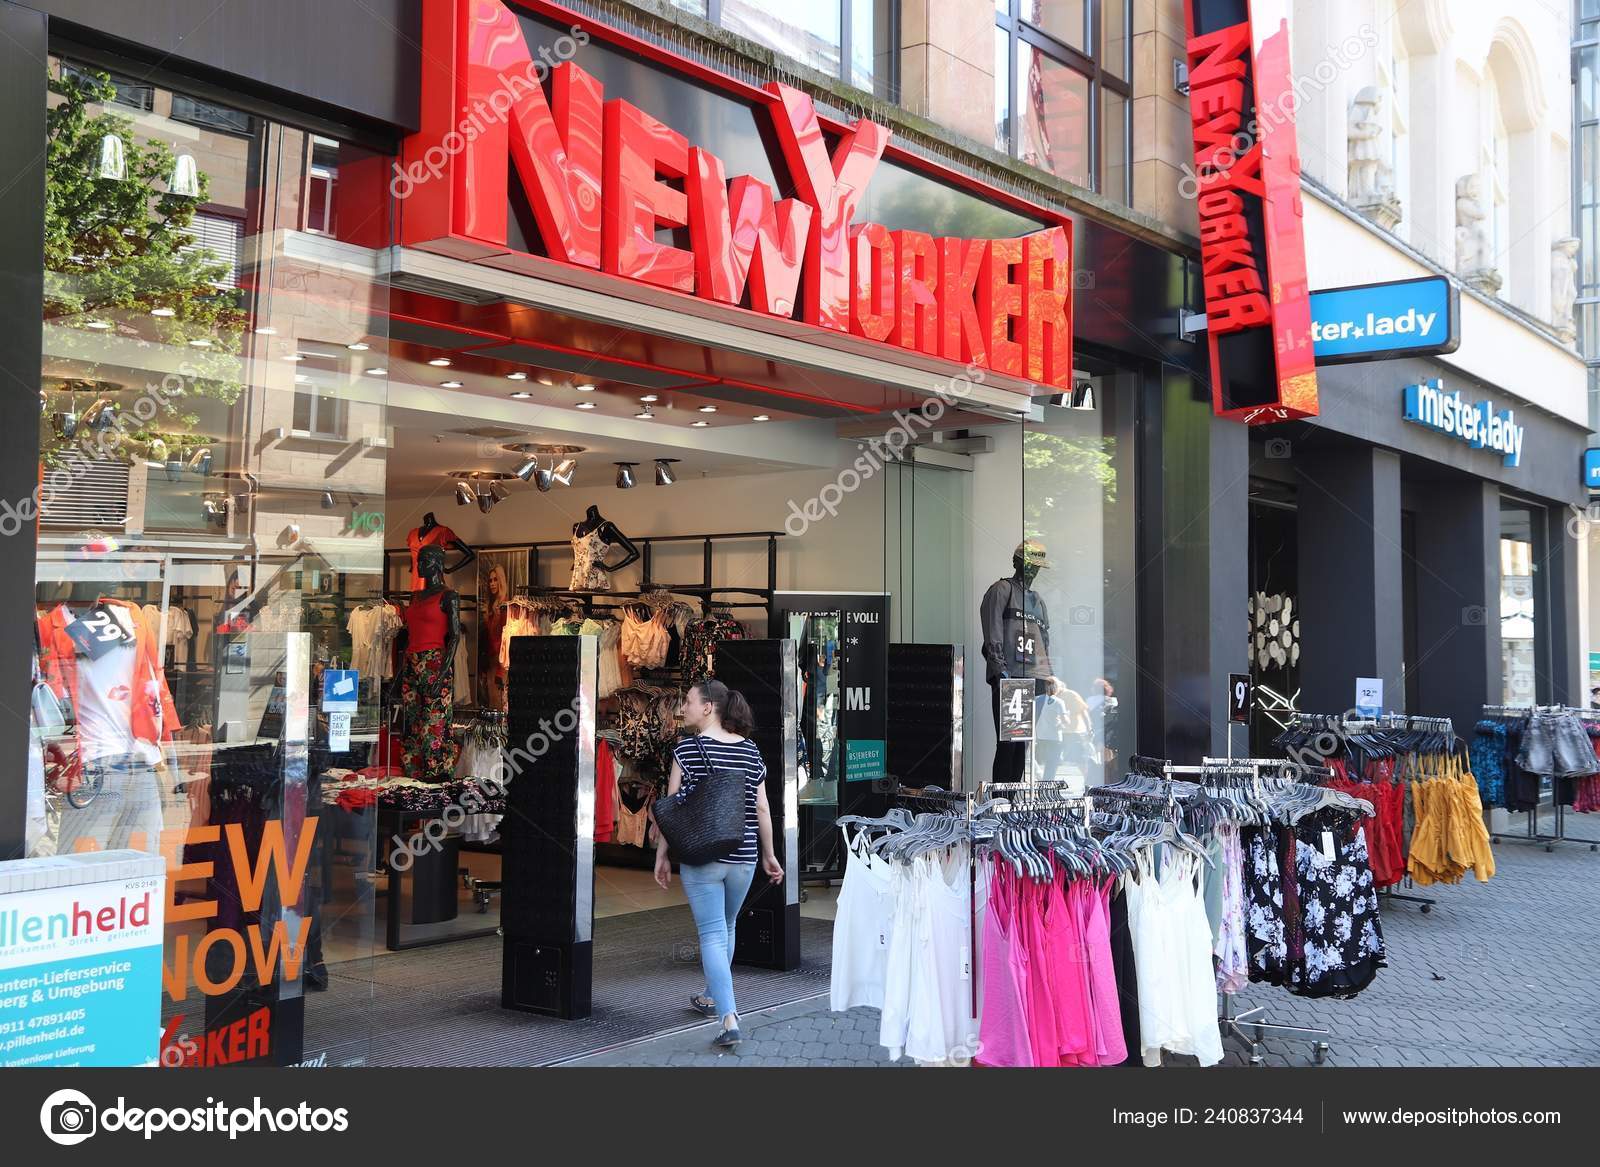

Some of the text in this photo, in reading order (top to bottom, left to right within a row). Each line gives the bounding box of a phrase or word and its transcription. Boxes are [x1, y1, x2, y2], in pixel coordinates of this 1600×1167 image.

[853, 612, 879, 623] VOLL!
[0, 977, 125, 1008] erg & Umgebung
[0, 1008, 86, 1035] 911 47891405
[55, 1043, 96, 1060] Lieferung
